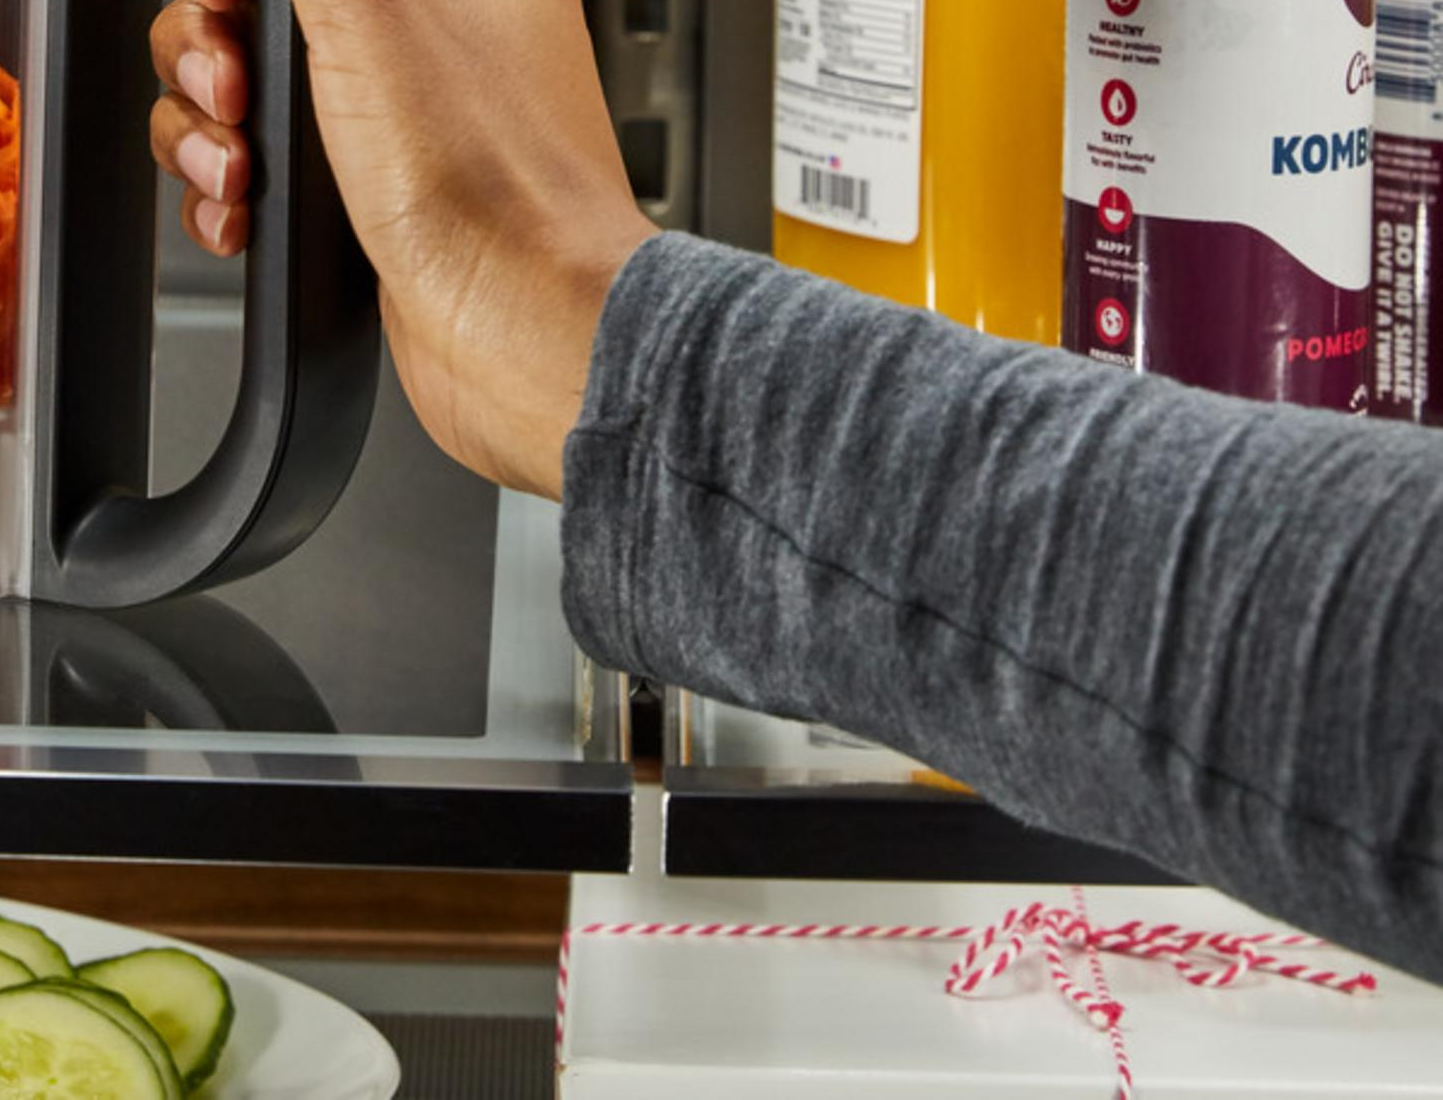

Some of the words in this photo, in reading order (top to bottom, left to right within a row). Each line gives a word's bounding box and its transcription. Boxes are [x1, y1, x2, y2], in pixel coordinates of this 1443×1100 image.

[1100, 21, 1145, 38] HEALTHY
[1102, 130, 1134, 146] TASTY
[1272, 126, 1374, 175] KOMB
[1377, 221, 1393, 283] GIVE
[1395, 224, 1414, 267] DO
[1377, 288, 1392, 306] IT
[1394, 272, 1413, 320] NOT
[1377, 310, 1392, 326] A
